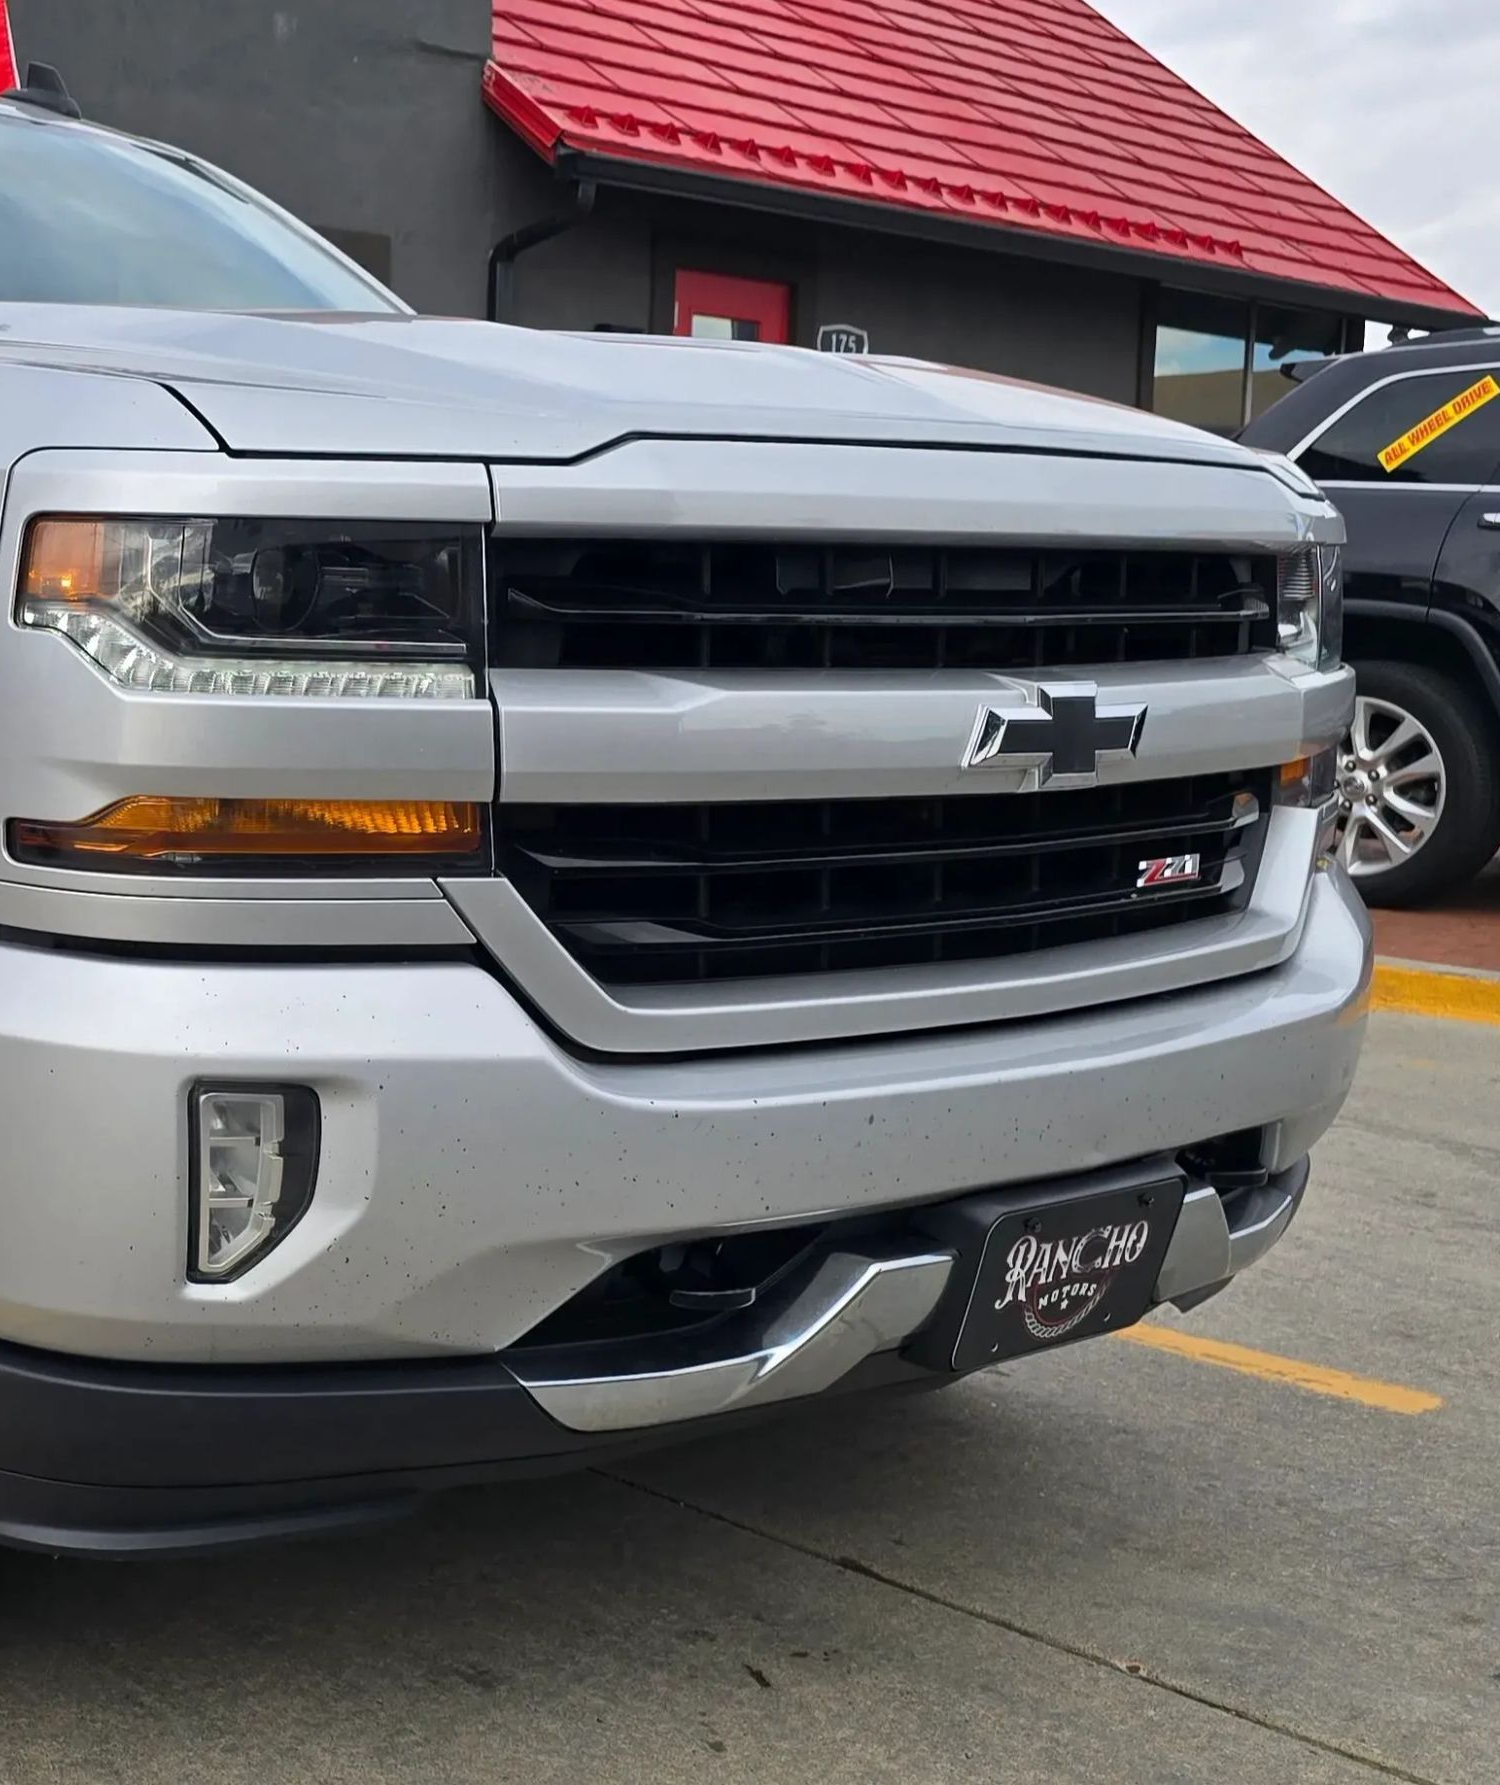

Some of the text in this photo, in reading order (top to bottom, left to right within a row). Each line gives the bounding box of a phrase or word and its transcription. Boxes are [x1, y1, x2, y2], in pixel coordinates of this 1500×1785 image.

[831, 333, 857, 354] 175
[1384, 380, 1495, 466] ALL WHEEL DRIVE
[1136, 853, 1200, 888] Z71
[994, 1219, 1149, 1310] RANCHO
[1037, 1281, 1097, 1310] MOTORS
